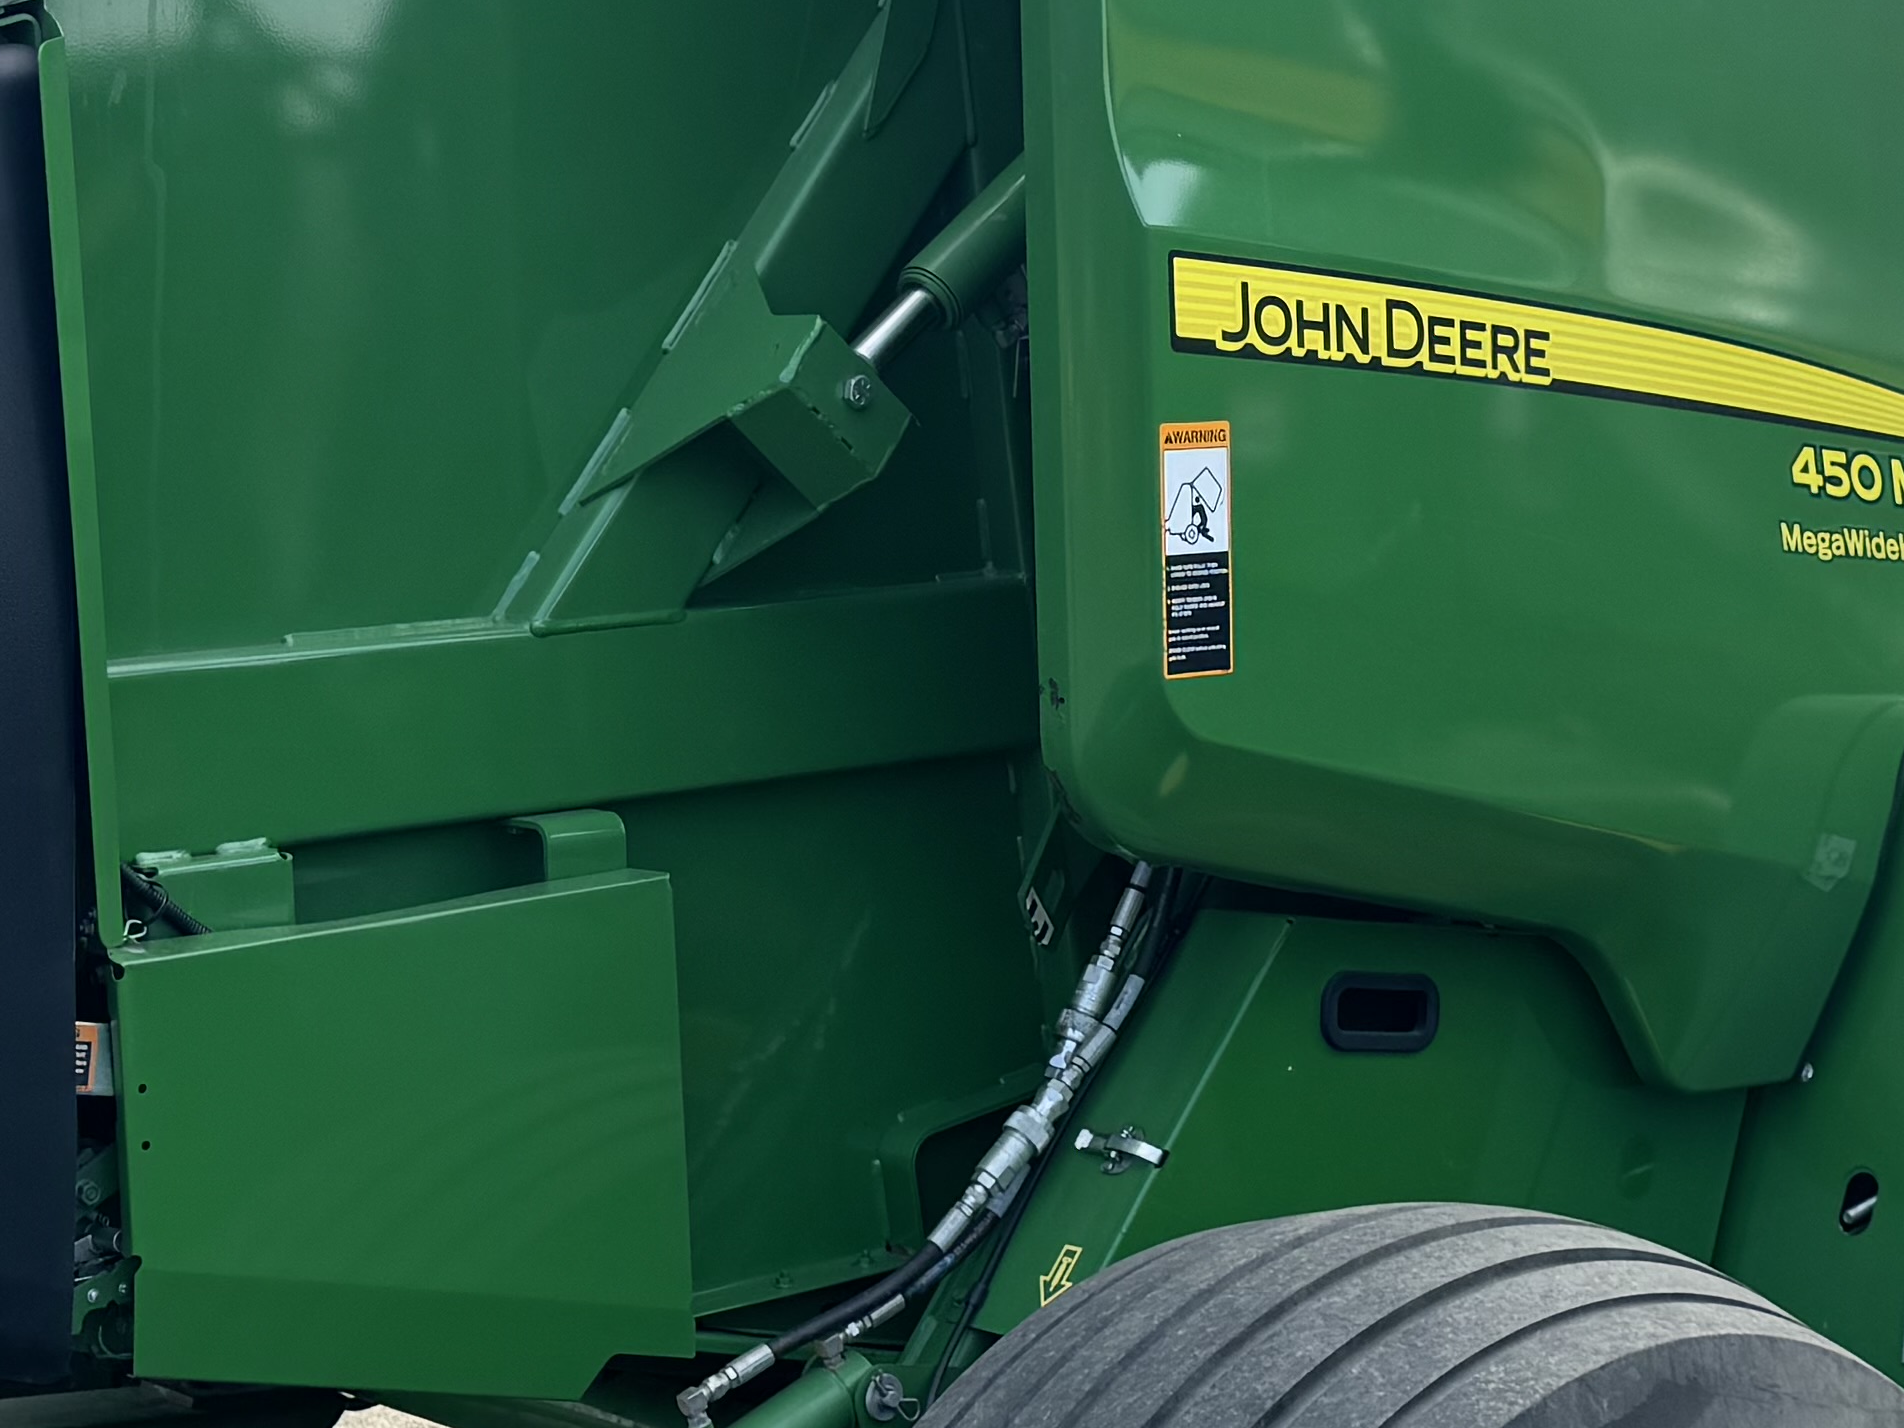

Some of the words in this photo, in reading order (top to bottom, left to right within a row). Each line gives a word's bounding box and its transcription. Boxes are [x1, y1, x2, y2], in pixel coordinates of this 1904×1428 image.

[1221, 281, 1370, 356] JOHN
[1385, 298, 1551, 377] DEERE
[1174, 429, 1227, 444] WARNING
[1791, 446, 1883, 502] 450
